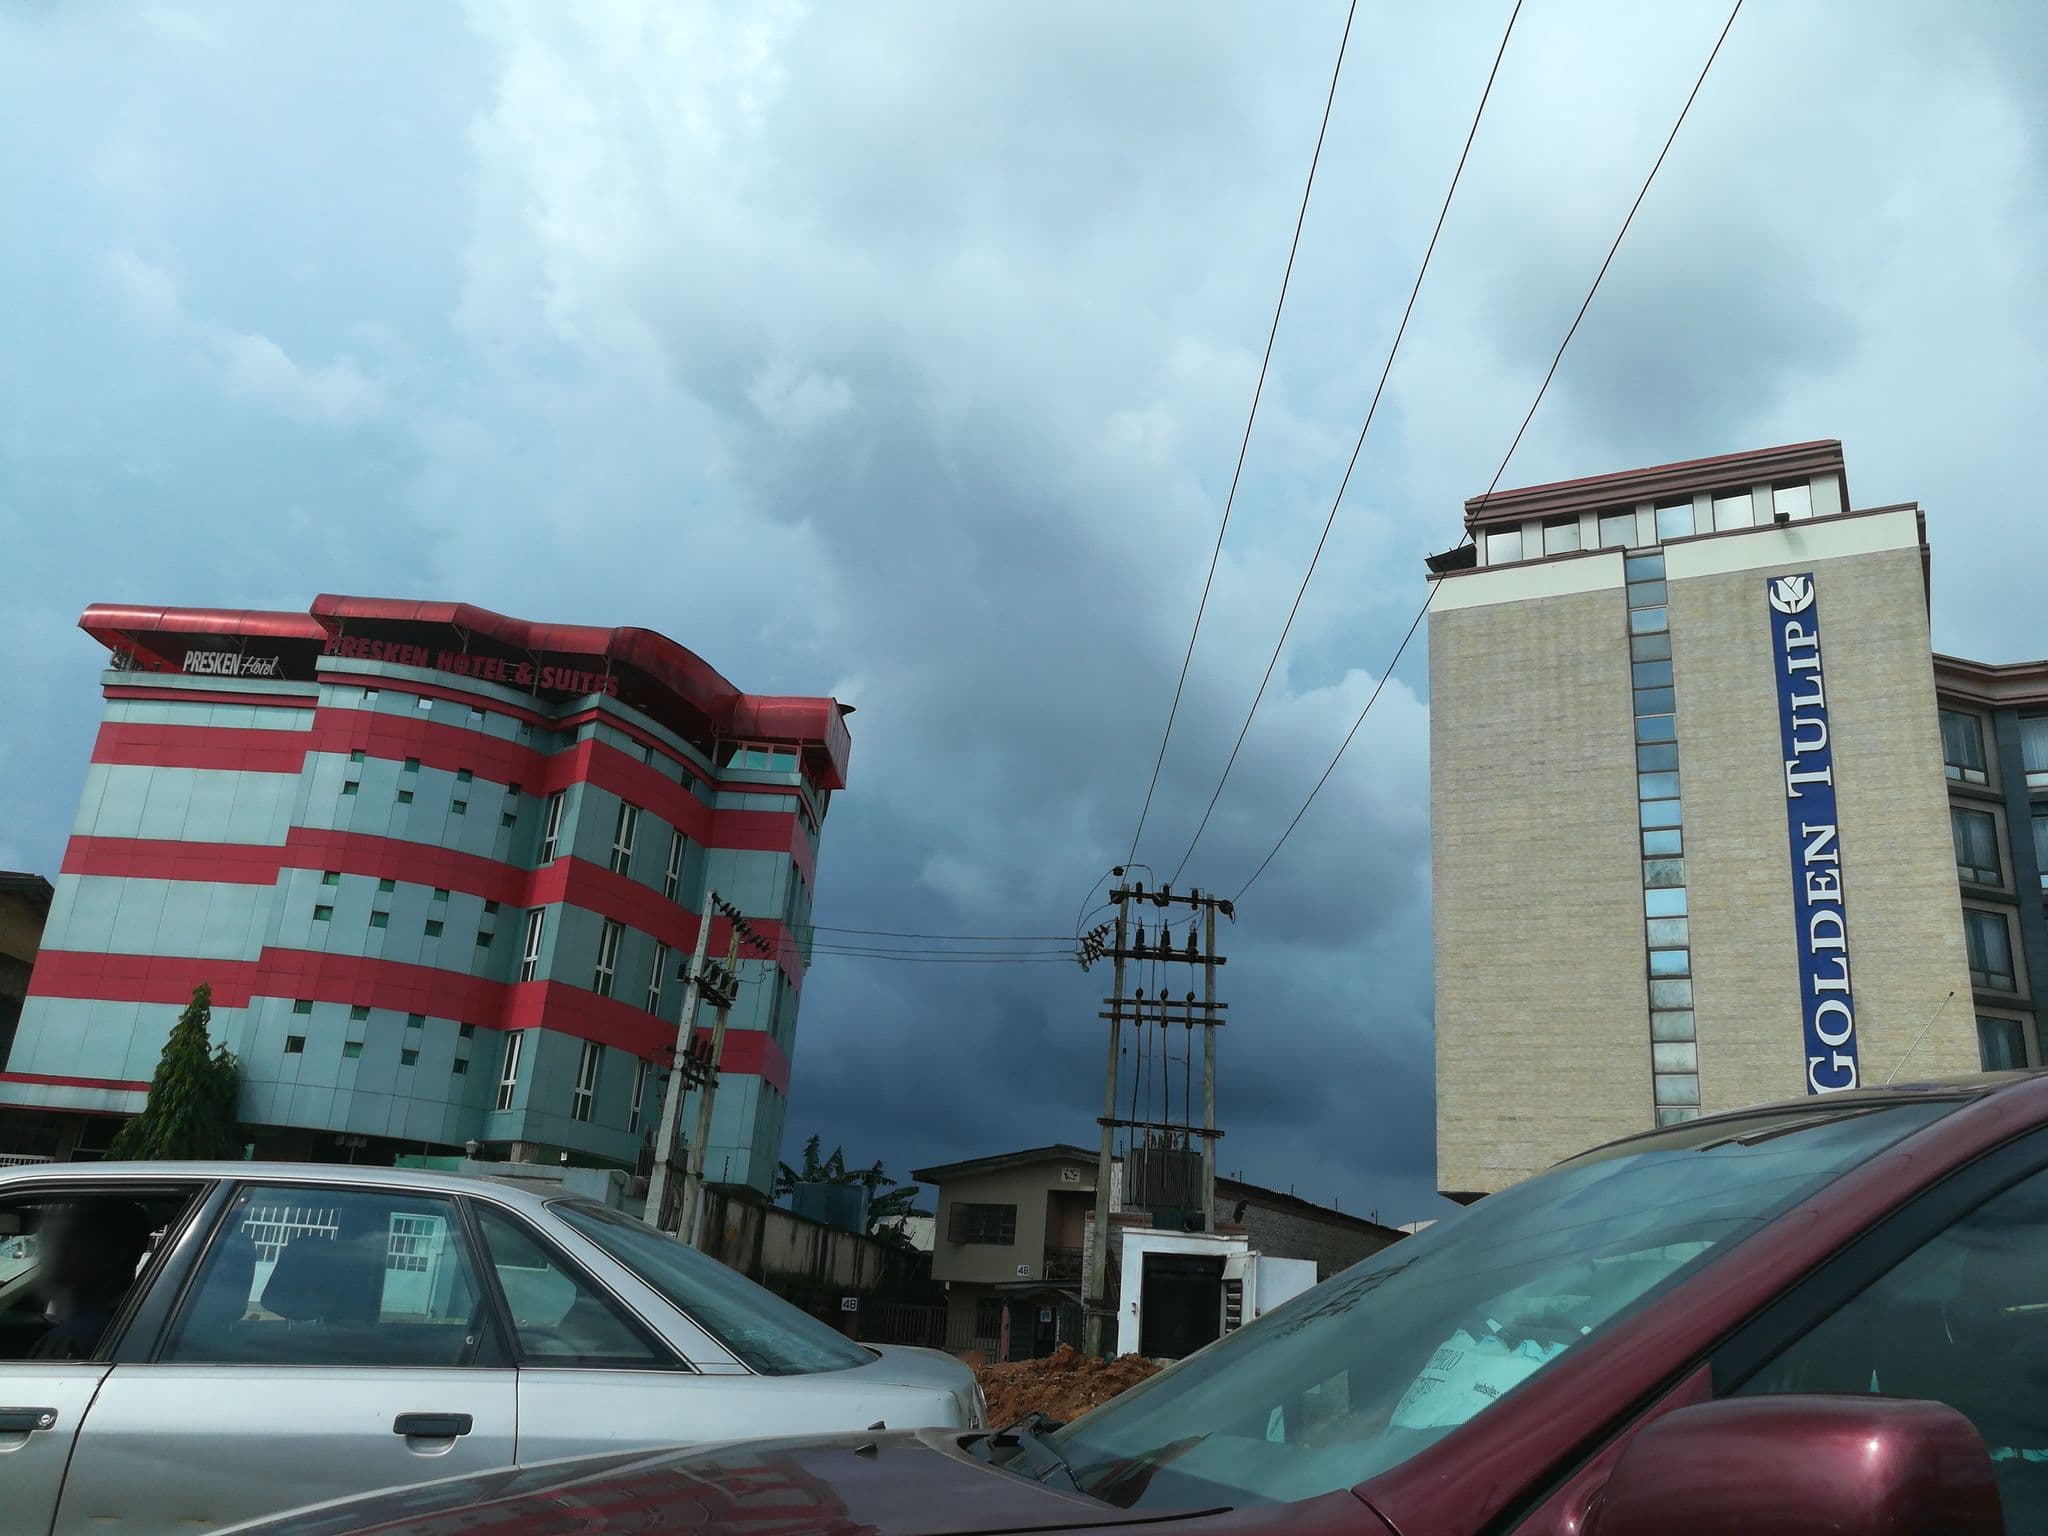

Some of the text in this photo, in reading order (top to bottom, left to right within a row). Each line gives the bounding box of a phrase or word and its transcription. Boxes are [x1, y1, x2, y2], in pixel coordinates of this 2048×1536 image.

[182, 650, 279, 676] PRESKEN Hotel
[325, 635, 619, 698] PRESKEN HOTEL & SUITES
[1784, 620, 1857, 1095] GOLDEN TULIP
